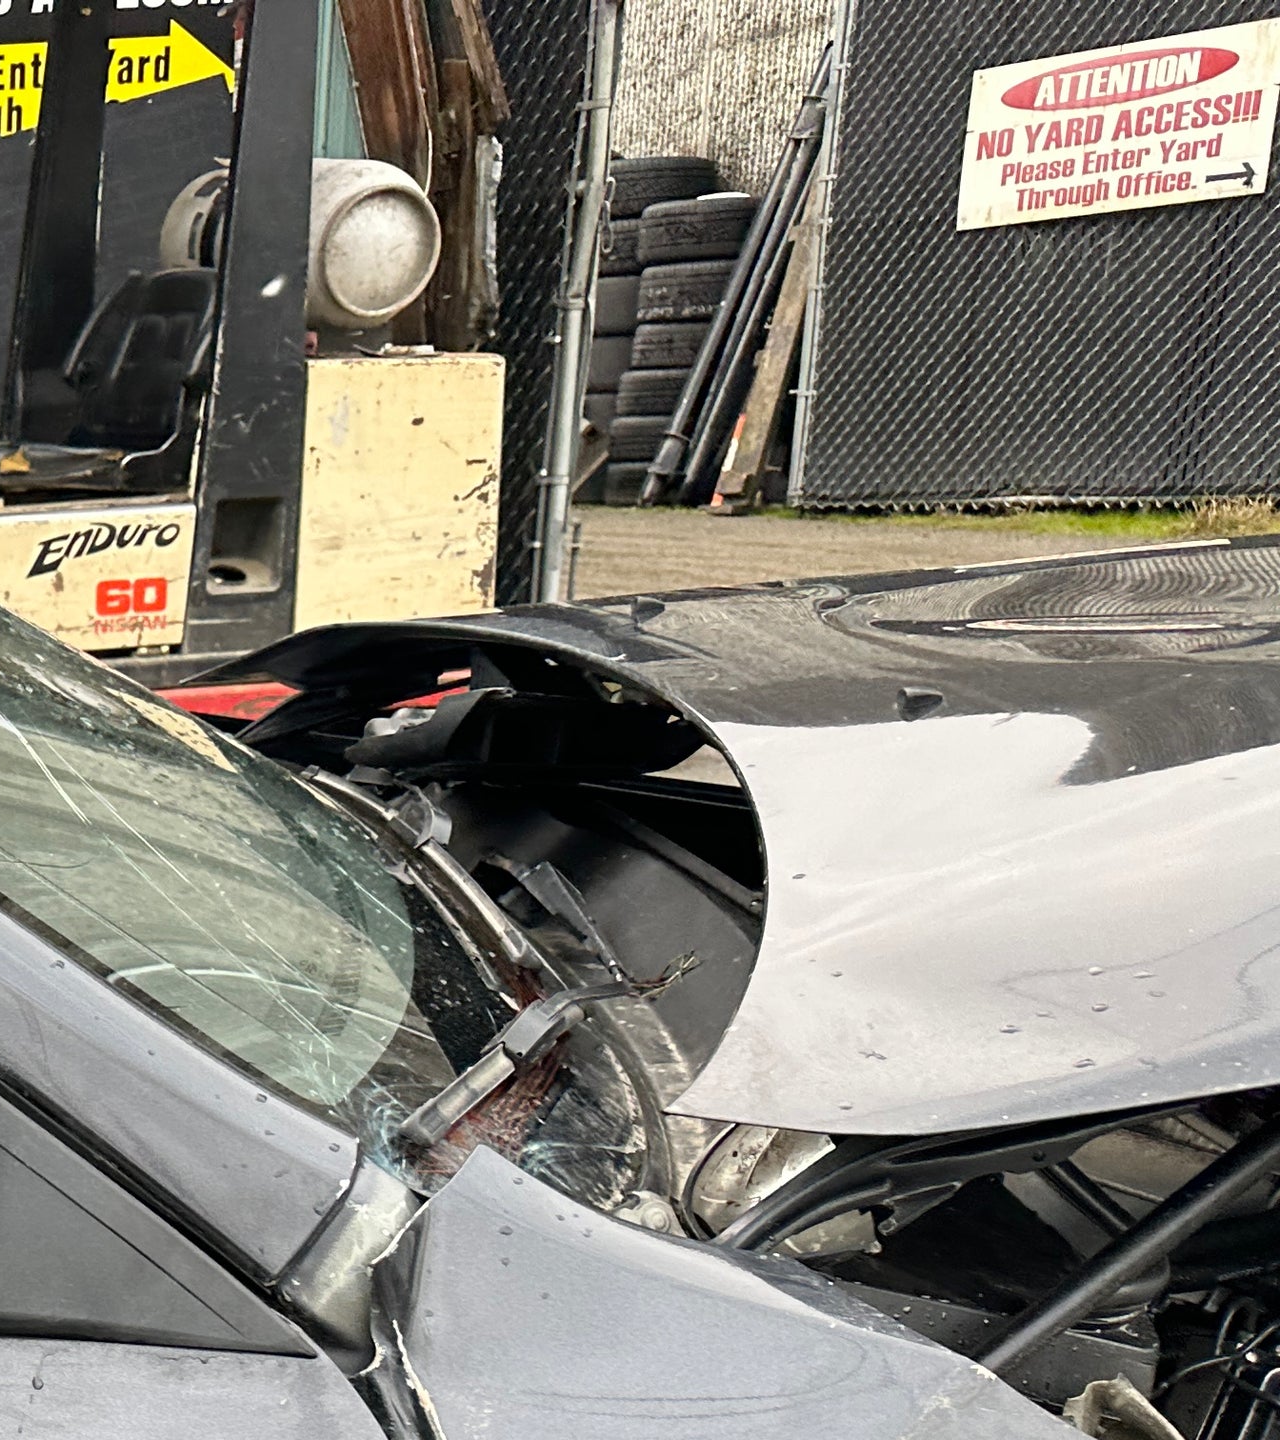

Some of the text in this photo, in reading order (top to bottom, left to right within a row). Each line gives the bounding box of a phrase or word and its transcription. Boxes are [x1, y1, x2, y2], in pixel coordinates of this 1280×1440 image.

[1034, 51, 1201, 107] ATTENTION
[976, 89, 1263, 161] NO YARD ACCESS!!!
[1001, 133, 1223, 186] Please Enter Yard
[1016, 170, 1197, 211] Through Office.
[96, 577, 168, 616] 60
